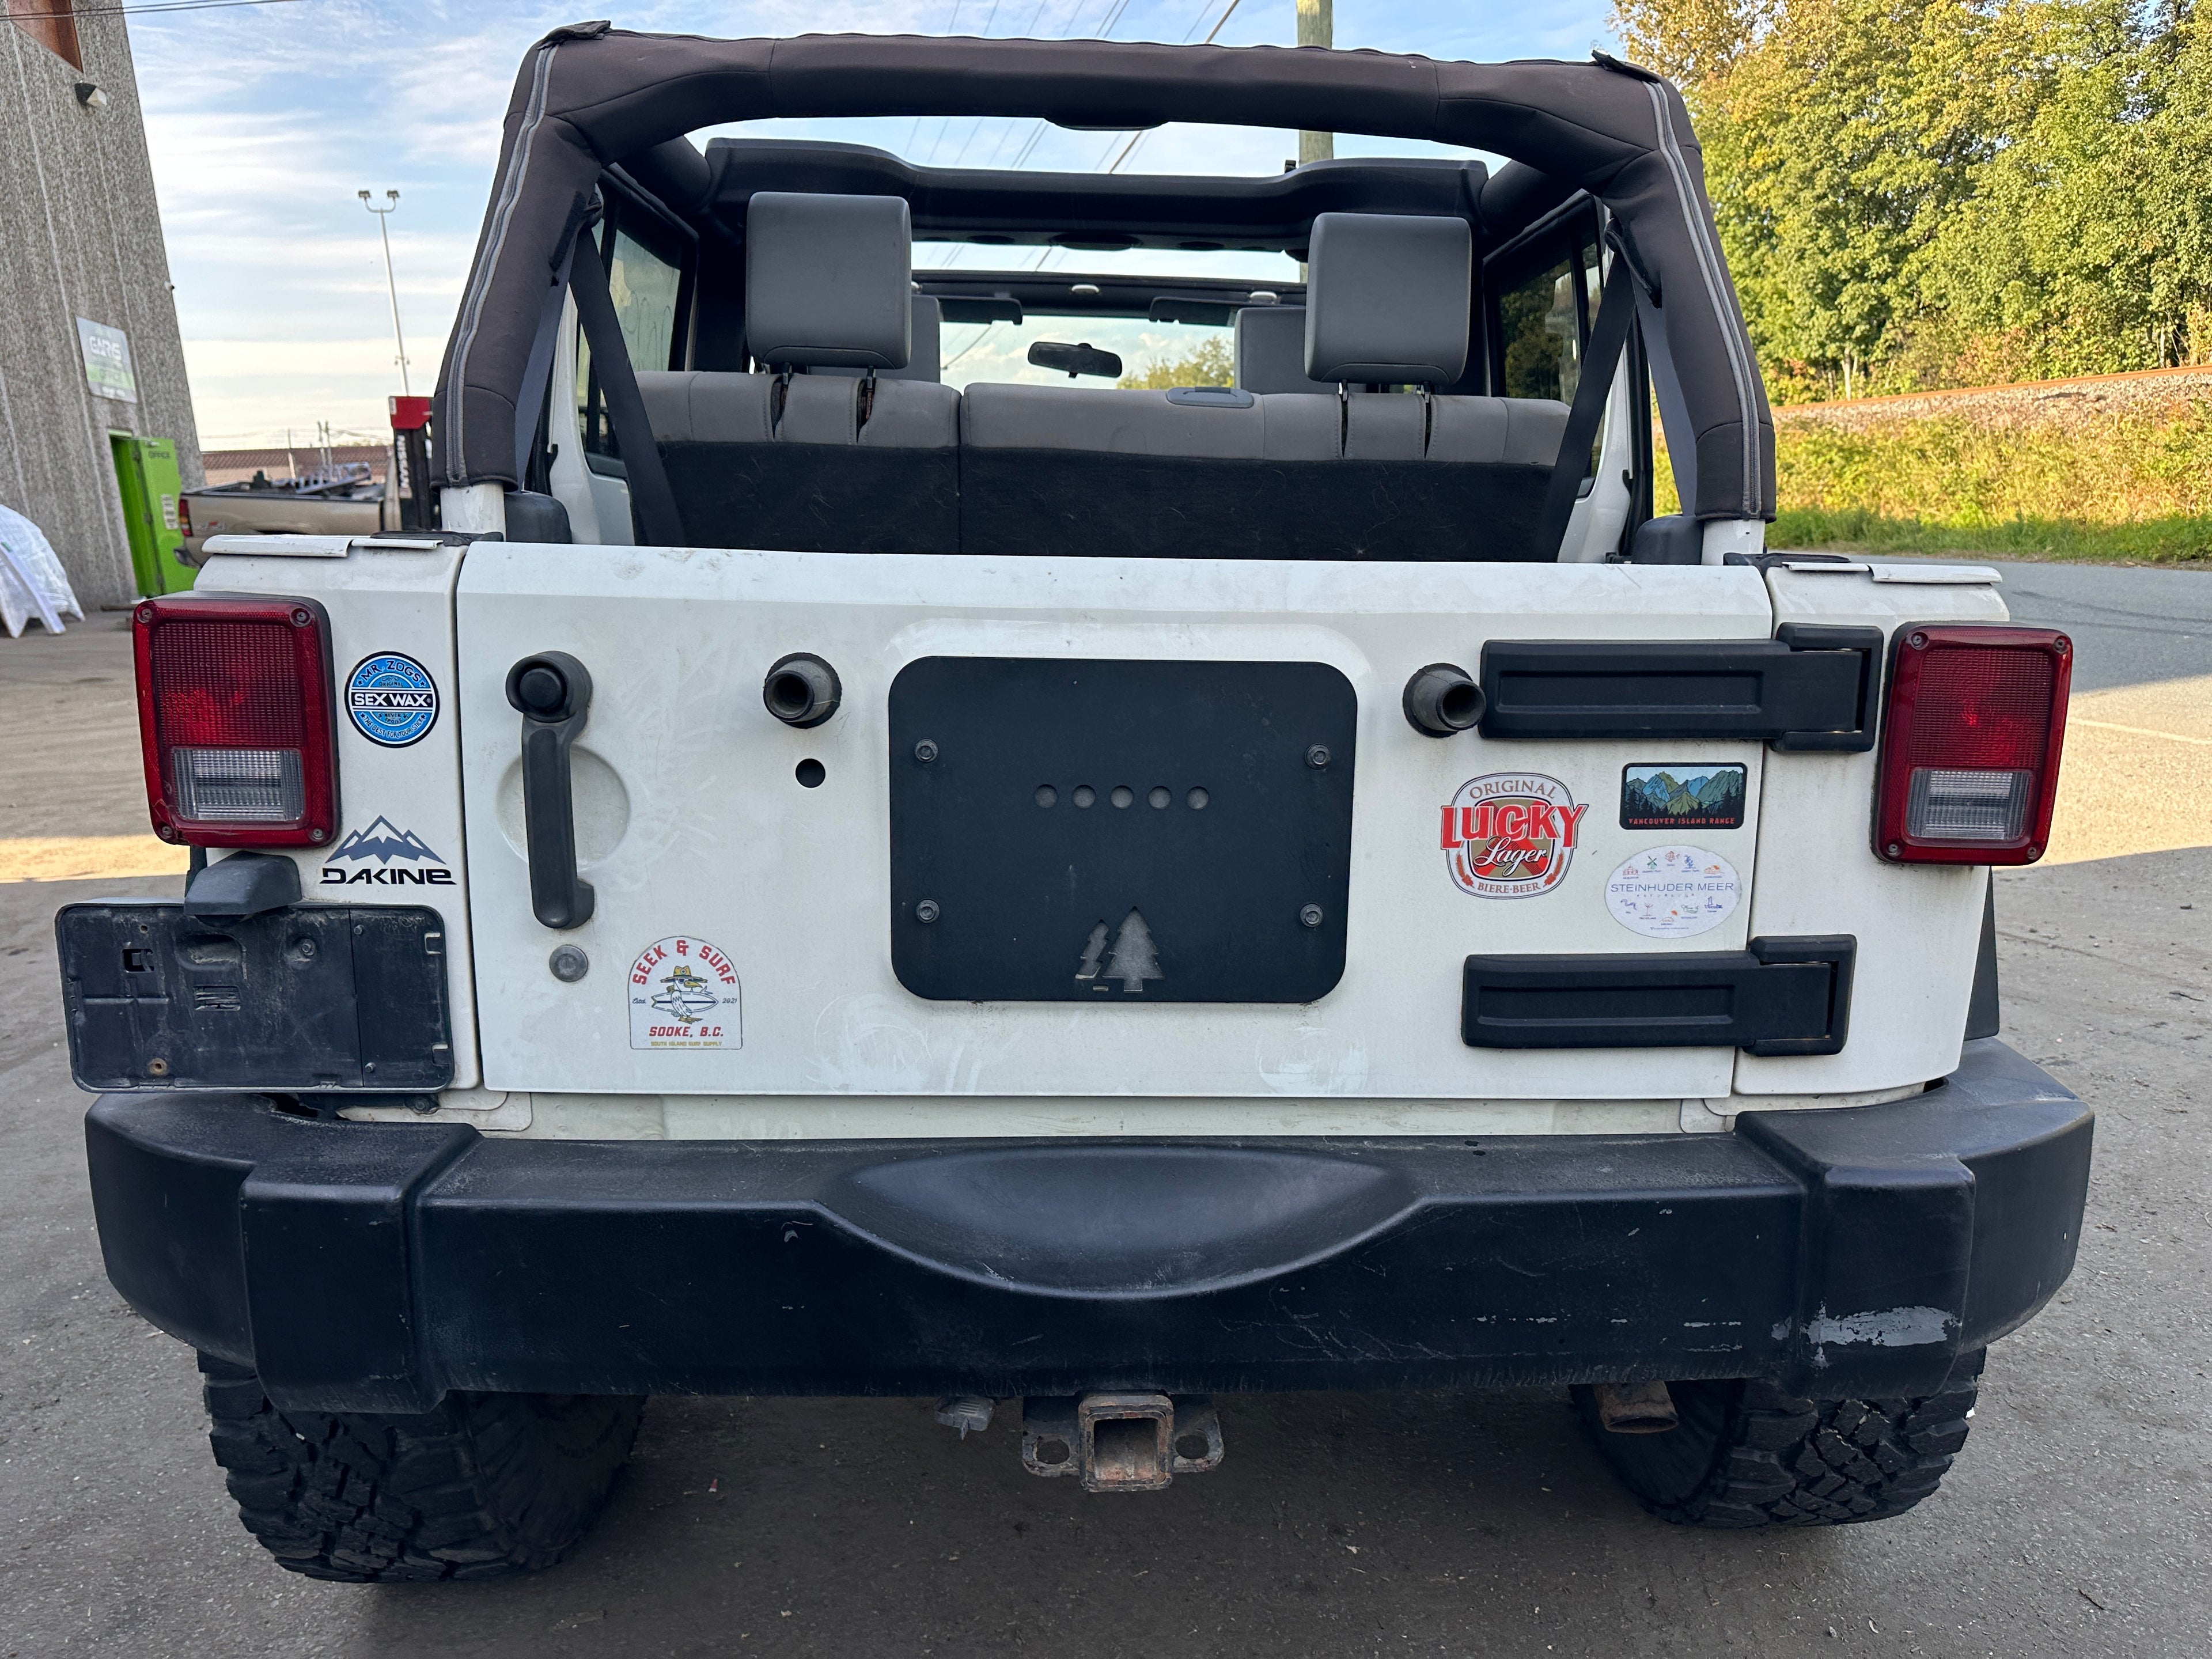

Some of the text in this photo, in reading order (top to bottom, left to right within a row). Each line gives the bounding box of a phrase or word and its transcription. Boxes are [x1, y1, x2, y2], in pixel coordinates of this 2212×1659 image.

[386, 660, 421, 683] ZOGS
[354, 693, 428, 707] SEX WAX
[363, 715, 372, 727] THE
[372, 725, 385, 736] BEST
[399, 728, 412, 737] YOUR
[412, 718, 424, 730] STICK
[1469, 780, 1556, 800] ORIGINAL
[1441, 805, 1588, 849] LUCKY
[1473, 836, 1547, 877] Lager
[319, 868, 457, 885] DAKINE
[1611, 882, 1734, 892] STEINHUDER MEER
[632, 940, 736, 984] SEEK & SURF
[649, 1026, 724, 1037] SOOKE, B.C.
